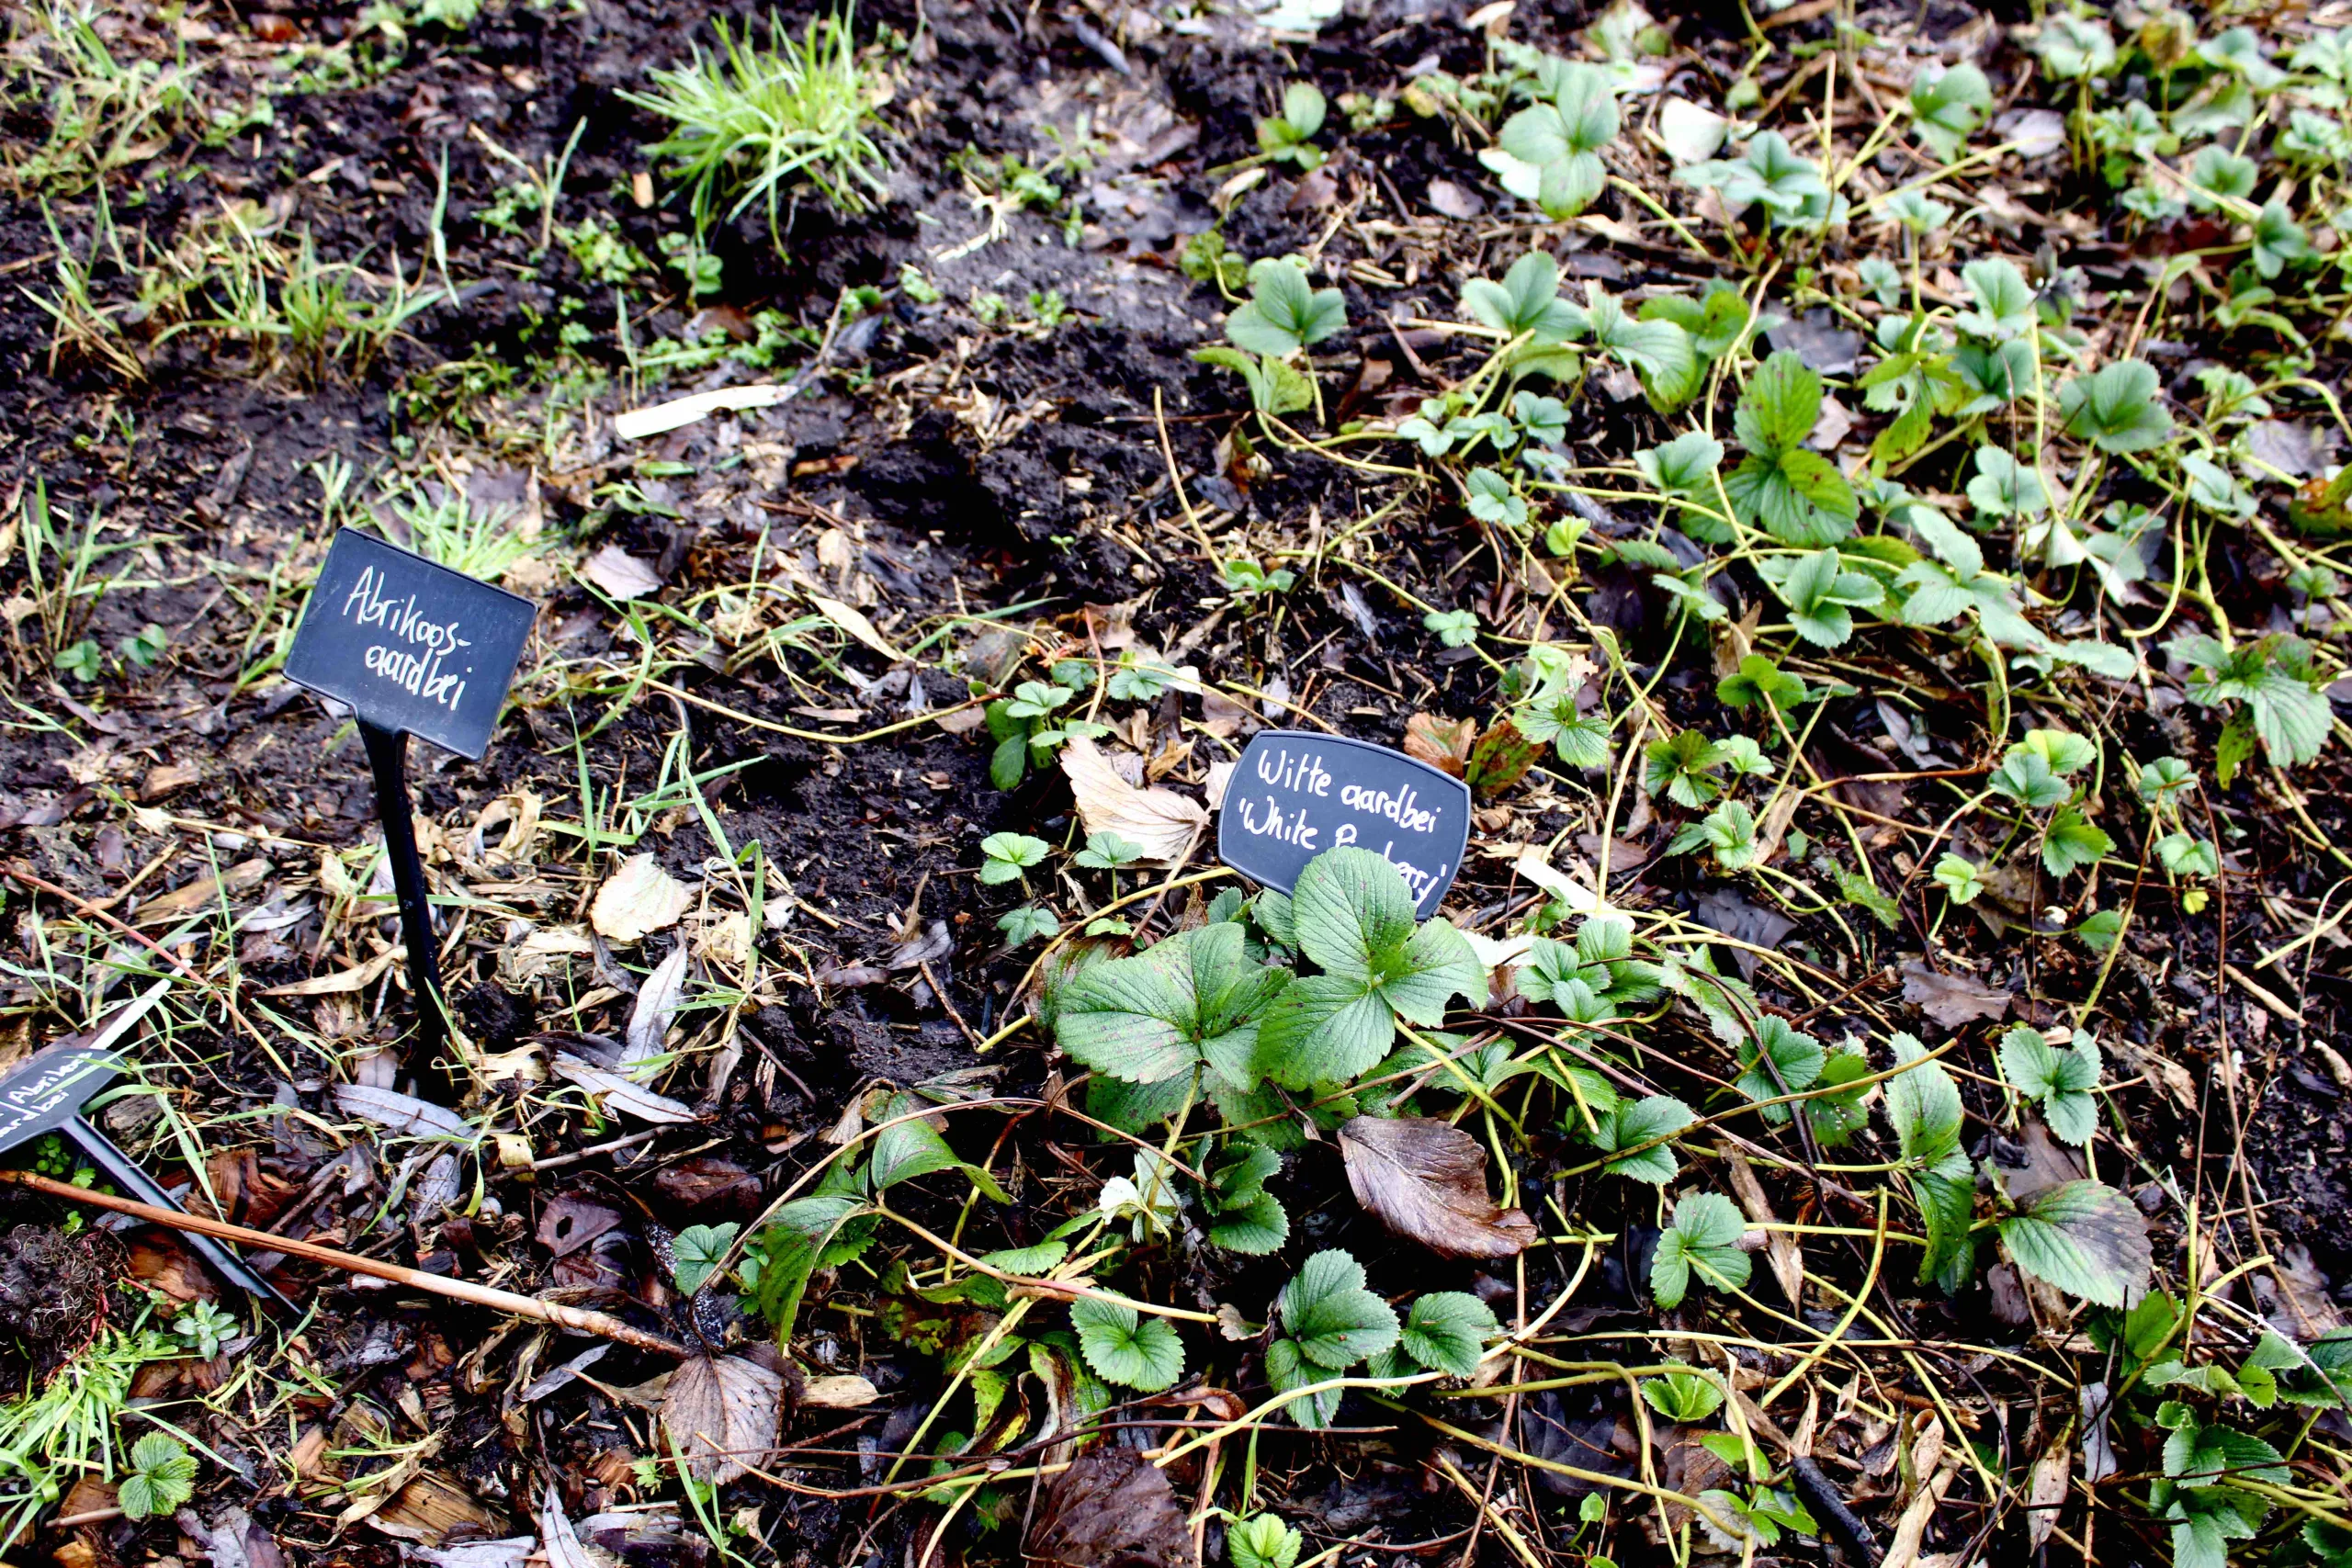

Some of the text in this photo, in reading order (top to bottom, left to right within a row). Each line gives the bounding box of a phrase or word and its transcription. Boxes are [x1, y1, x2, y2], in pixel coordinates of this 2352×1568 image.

[343, 565, 471, 656] Abrikoos-
[365, 645, 472, 711] aardbei
[1239, 795, 1318, 850] 'White
[1258, 749, 1442, 833] Witte aardbei
[0, 1089, 69, 1138] ardbei
